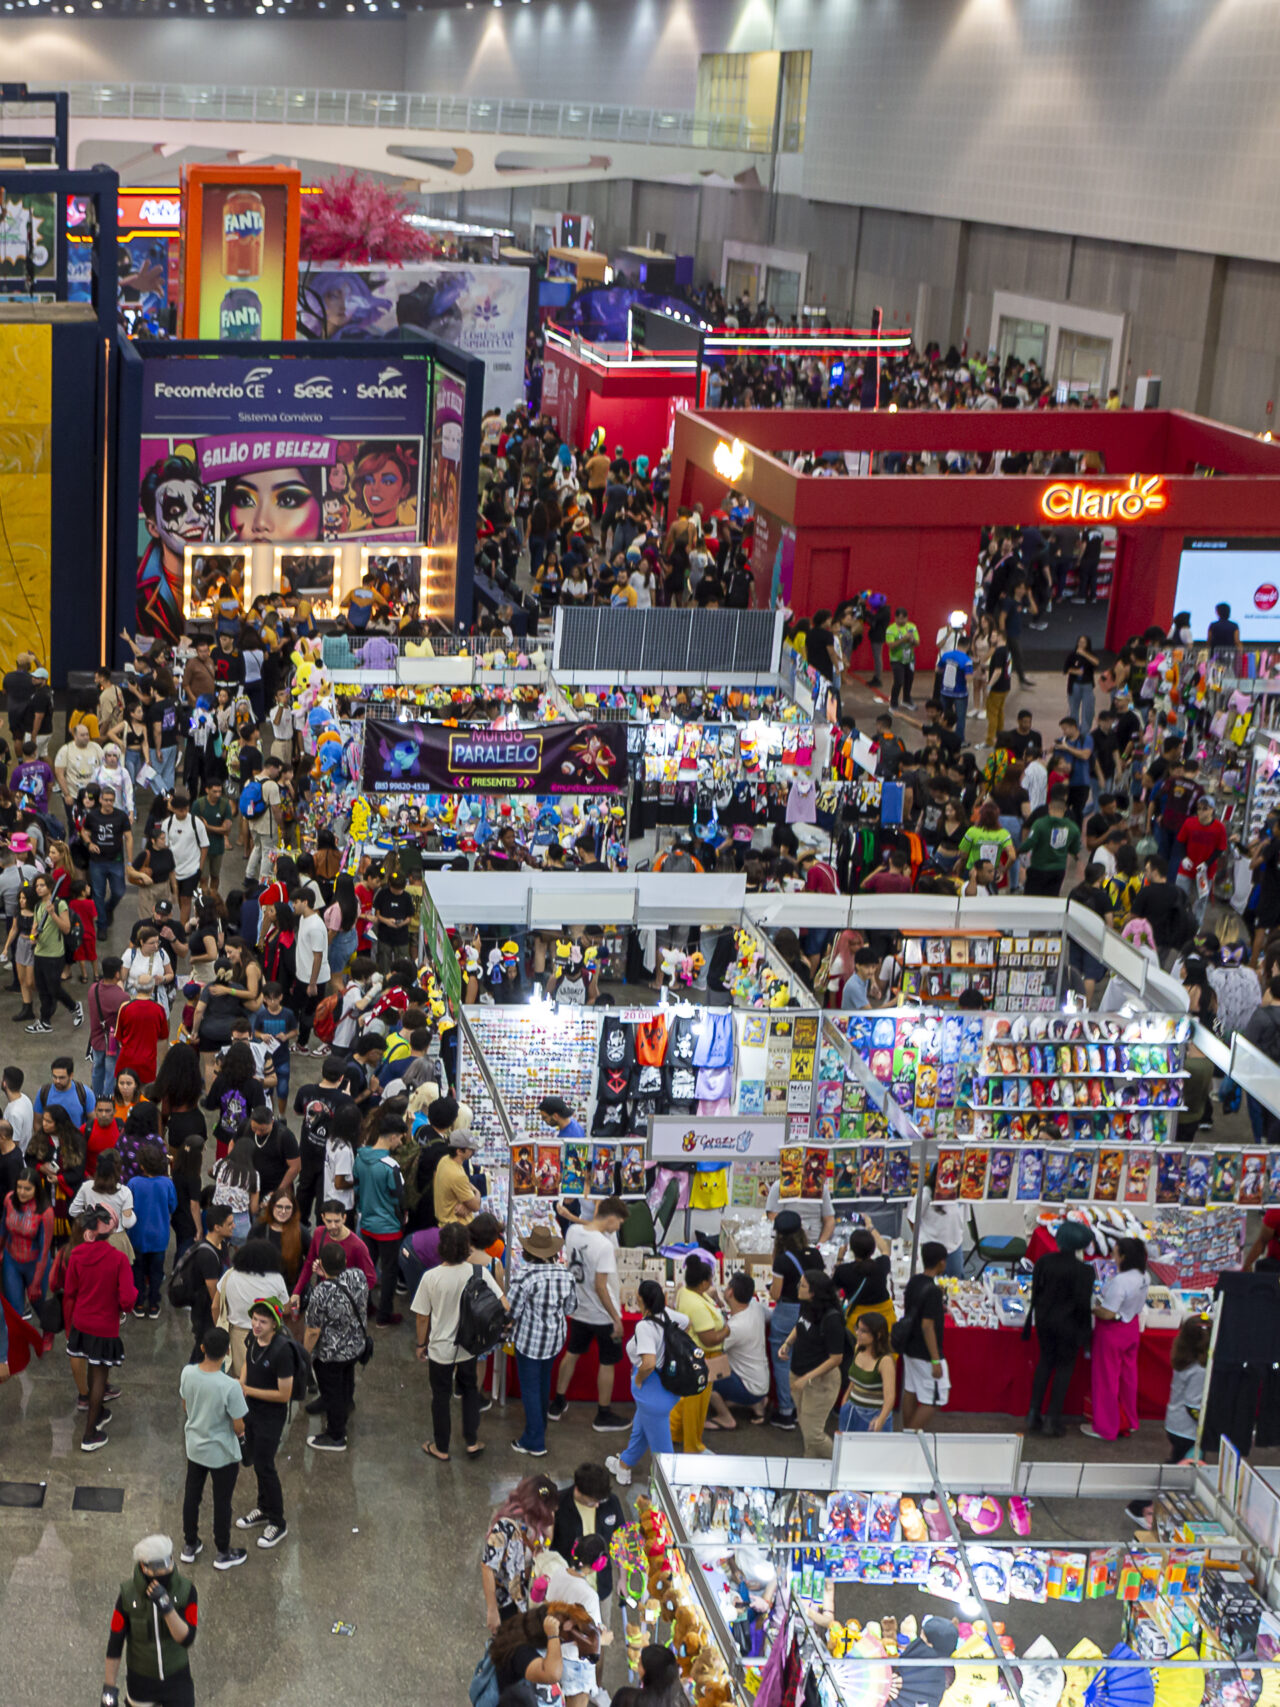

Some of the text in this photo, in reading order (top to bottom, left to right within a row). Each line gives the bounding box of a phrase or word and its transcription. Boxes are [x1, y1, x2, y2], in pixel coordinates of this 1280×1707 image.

[154, 382, 265, 399] Fecomércio CE
[293, 382, 333, 399] Sesc
[356, 381, 407, 400] Senac
[238, 412, 323, 422] Sistema Comércio
[202, 440, 330, 468] SALÃO DE BELEZA
[1042, 475, 1165, 520] Claro
[217, 659, 229, 680] R
[472, 730, 523, 742] Mundo
[454, 745, 537, 764] PARALELO
[471, 777, 517, 788] PRESENTES
